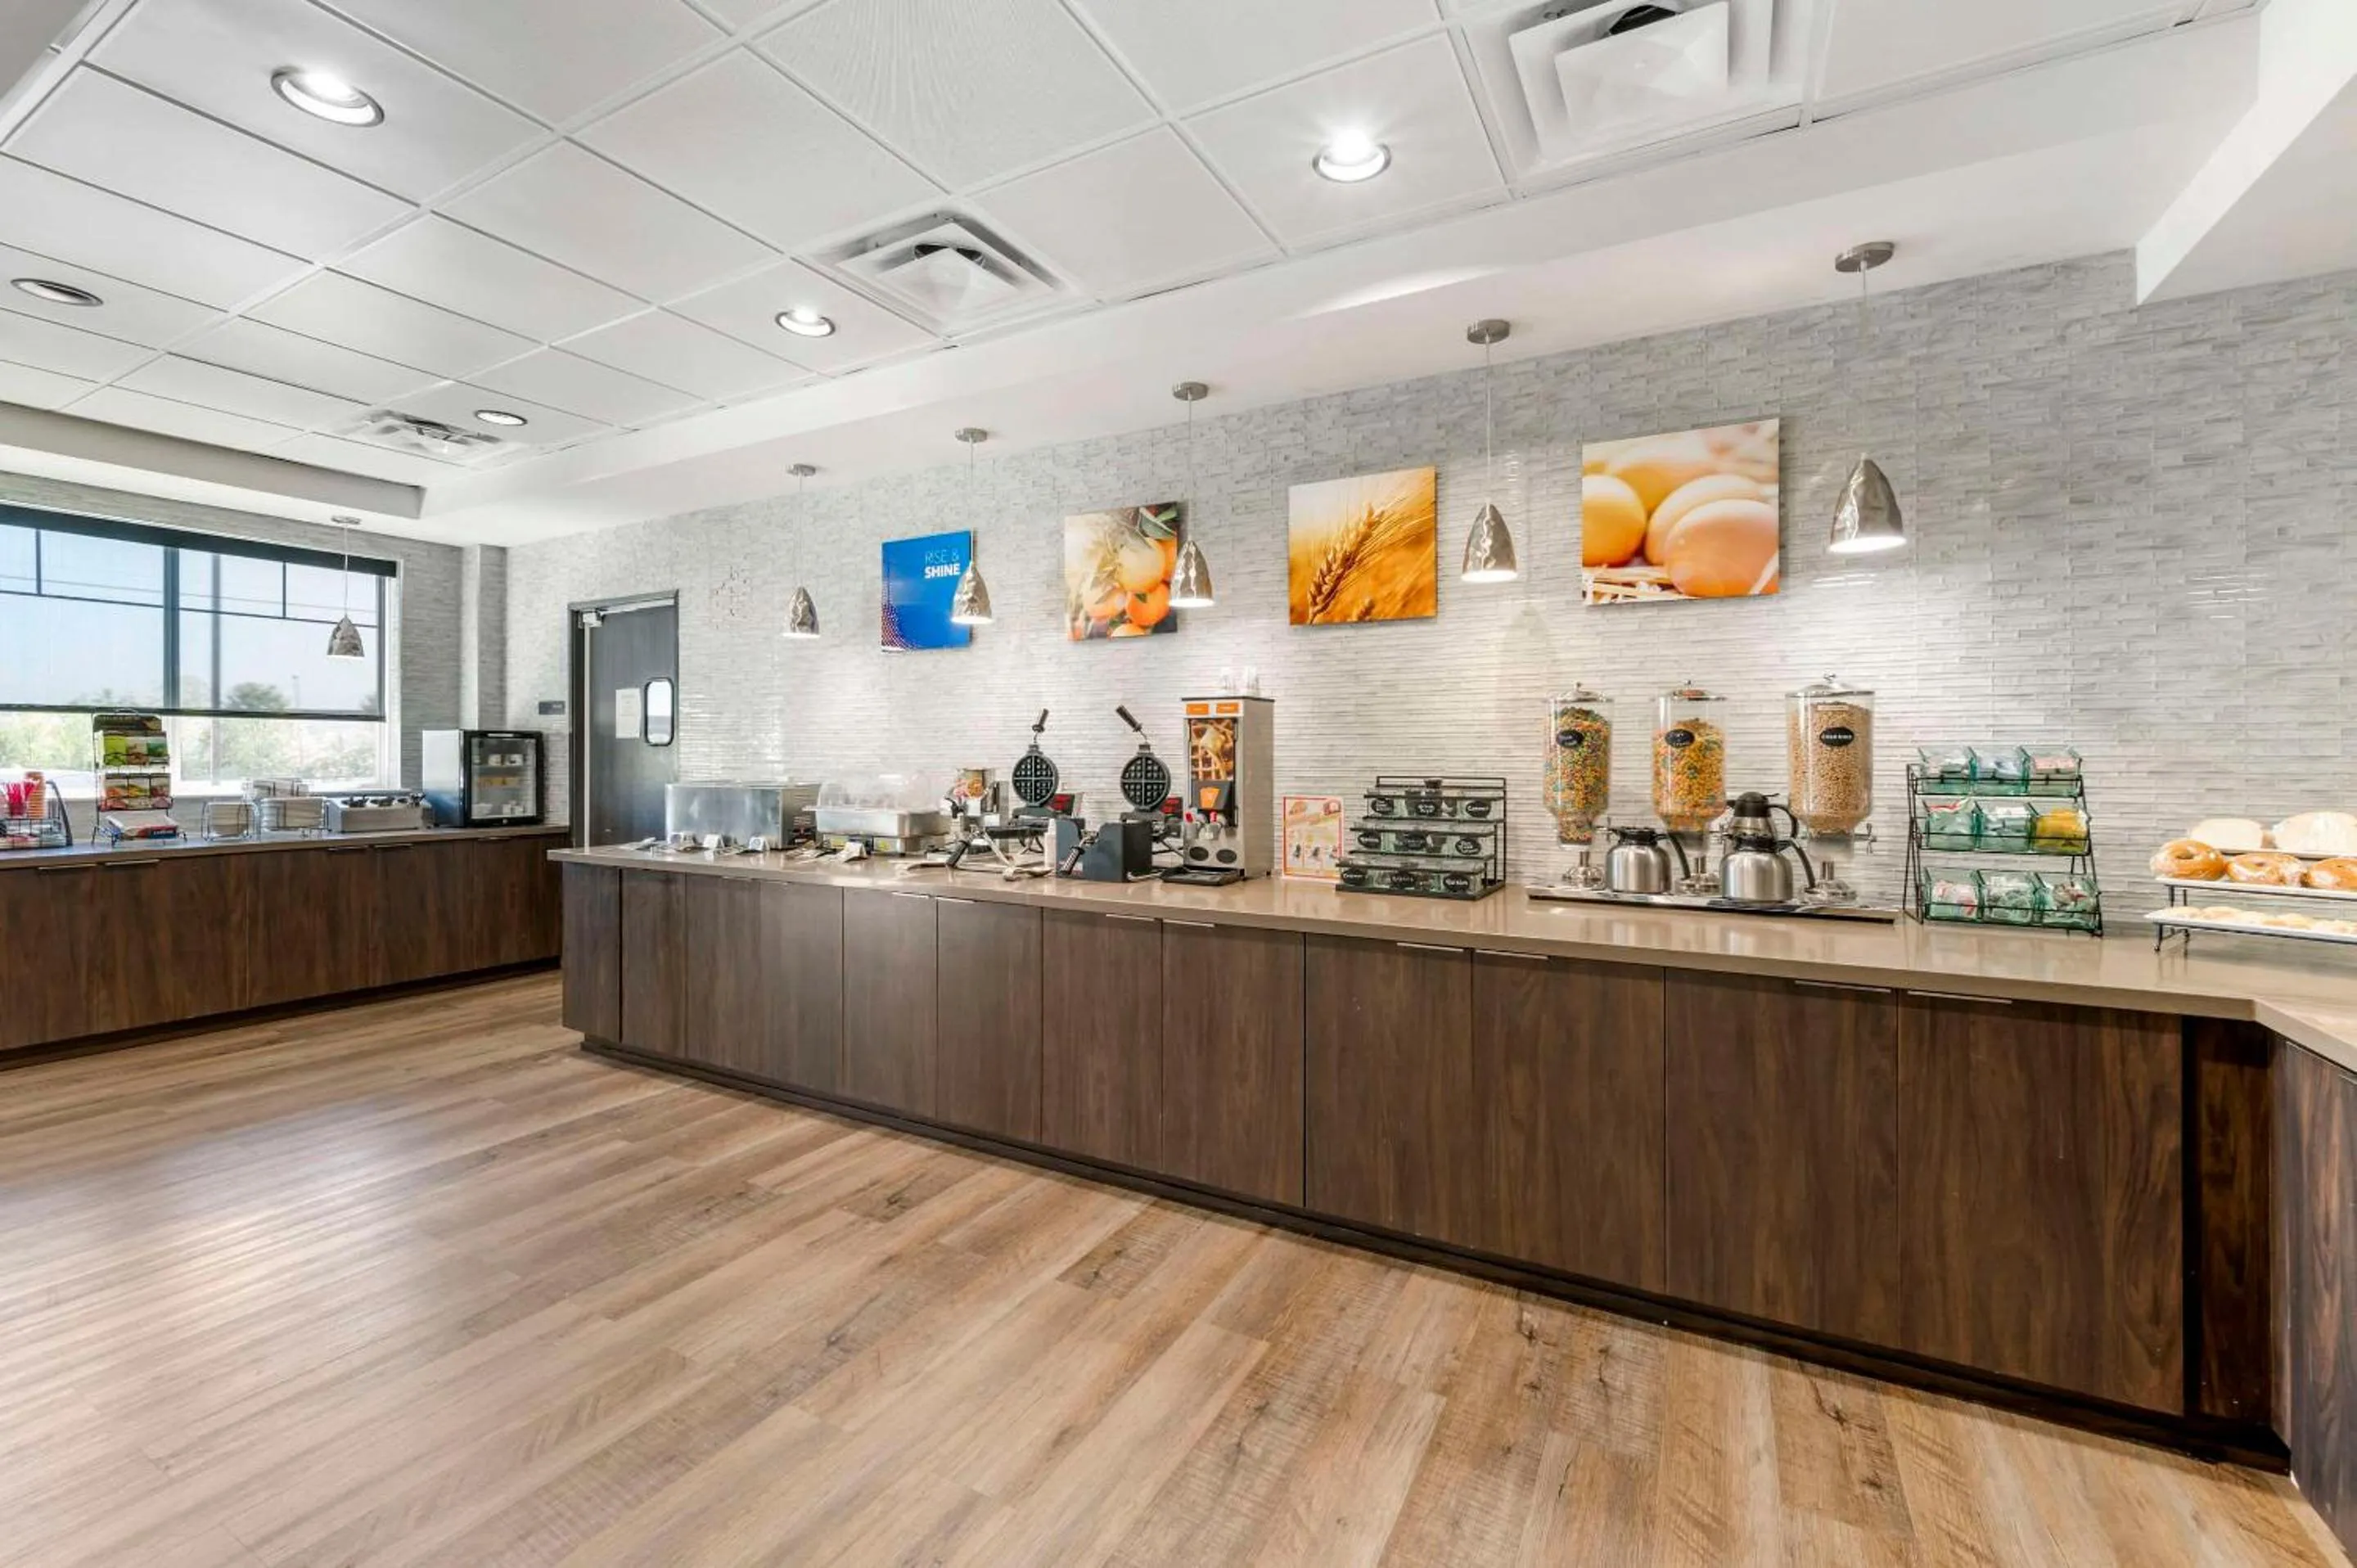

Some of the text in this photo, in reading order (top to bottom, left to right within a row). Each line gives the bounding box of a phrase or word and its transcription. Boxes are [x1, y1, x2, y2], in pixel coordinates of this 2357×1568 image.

[925, 547, 959, 565] RISE &
[924, 563, 961, 579] SHINE
